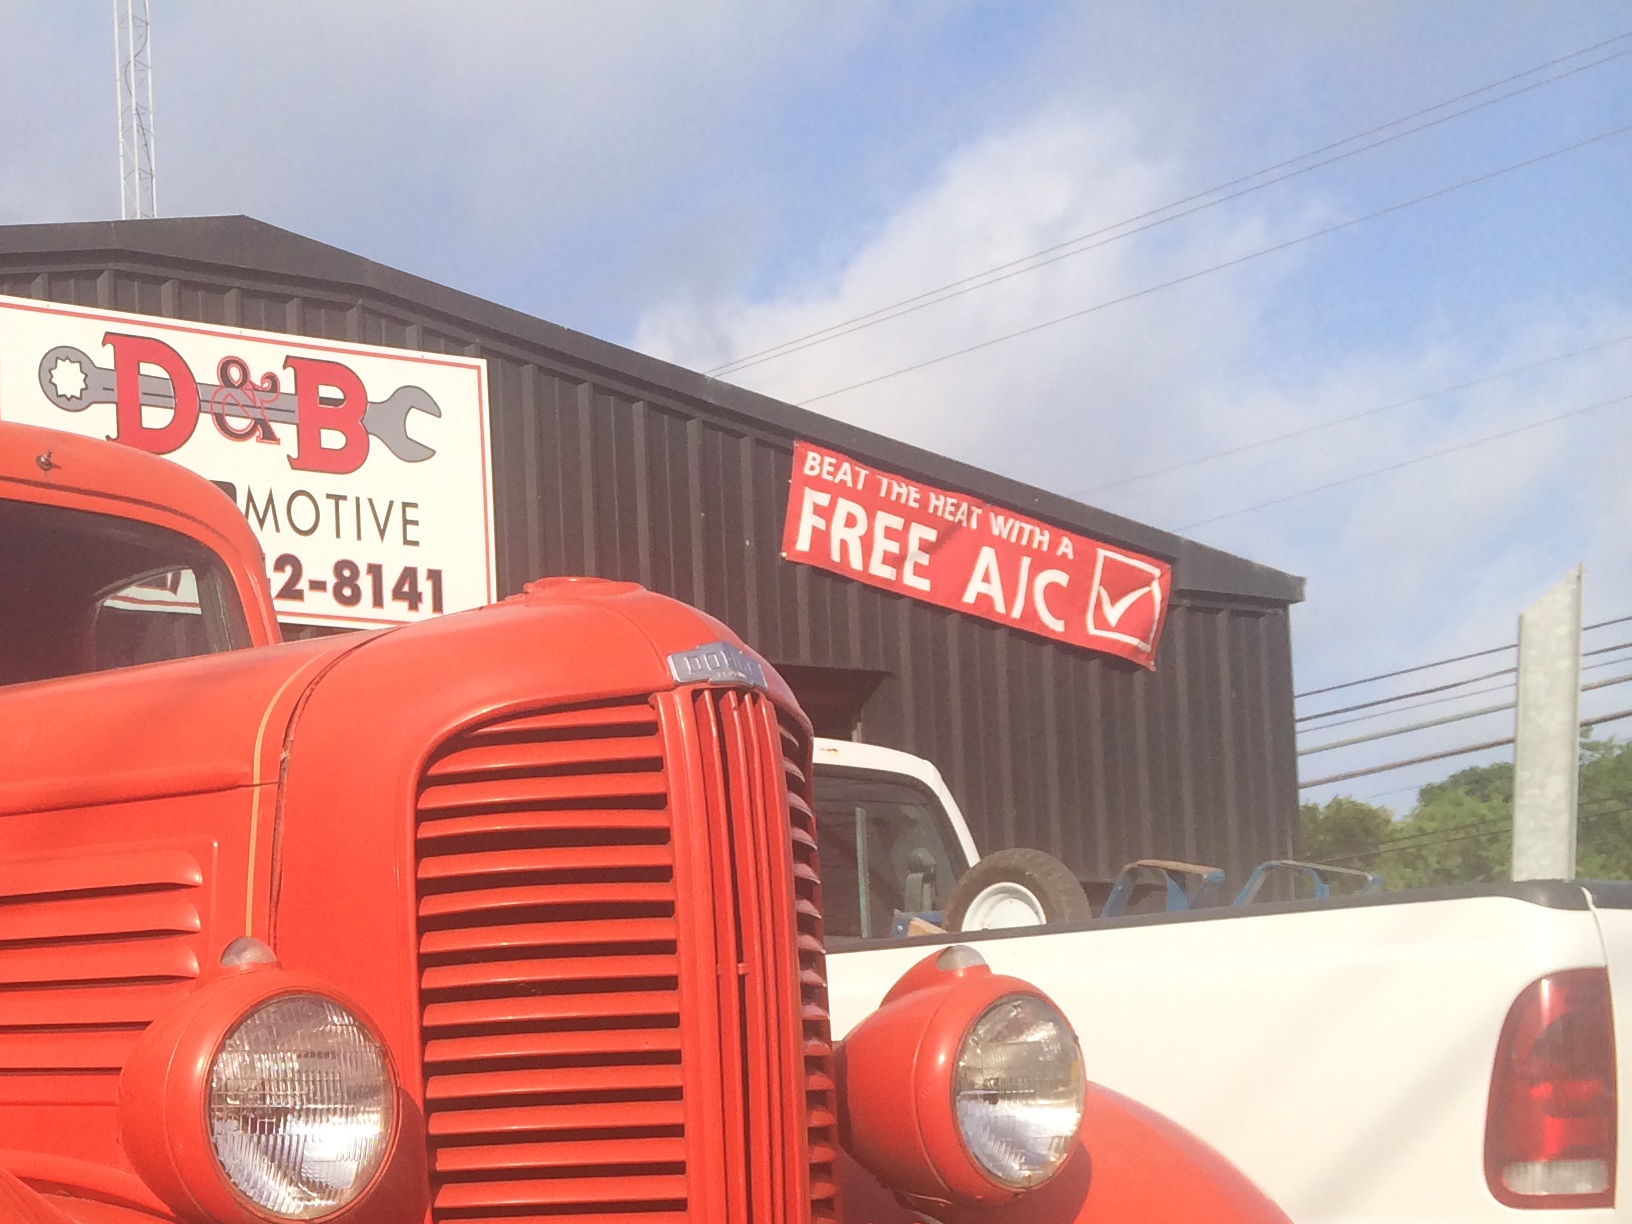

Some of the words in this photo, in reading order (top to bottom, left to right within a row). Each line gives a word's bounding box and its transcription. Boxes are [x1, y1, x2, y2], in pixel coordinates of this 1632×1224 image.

[102, 331, 370, 475] D&B
[209, 480, 420, 548] MOTIVE
[795, 486, 938, 592] FREE
[962, 545, 1071, 632] A/C
[803, 450, 870, 491] BEAT
[876, 474, 920, 508] THE
[928, 491, 983, 530] HEAT
[989, 511, 1051, 553] WITH
[1055, 535, 1074, 560] A
[264, 552, 444, 615] 2-8141
